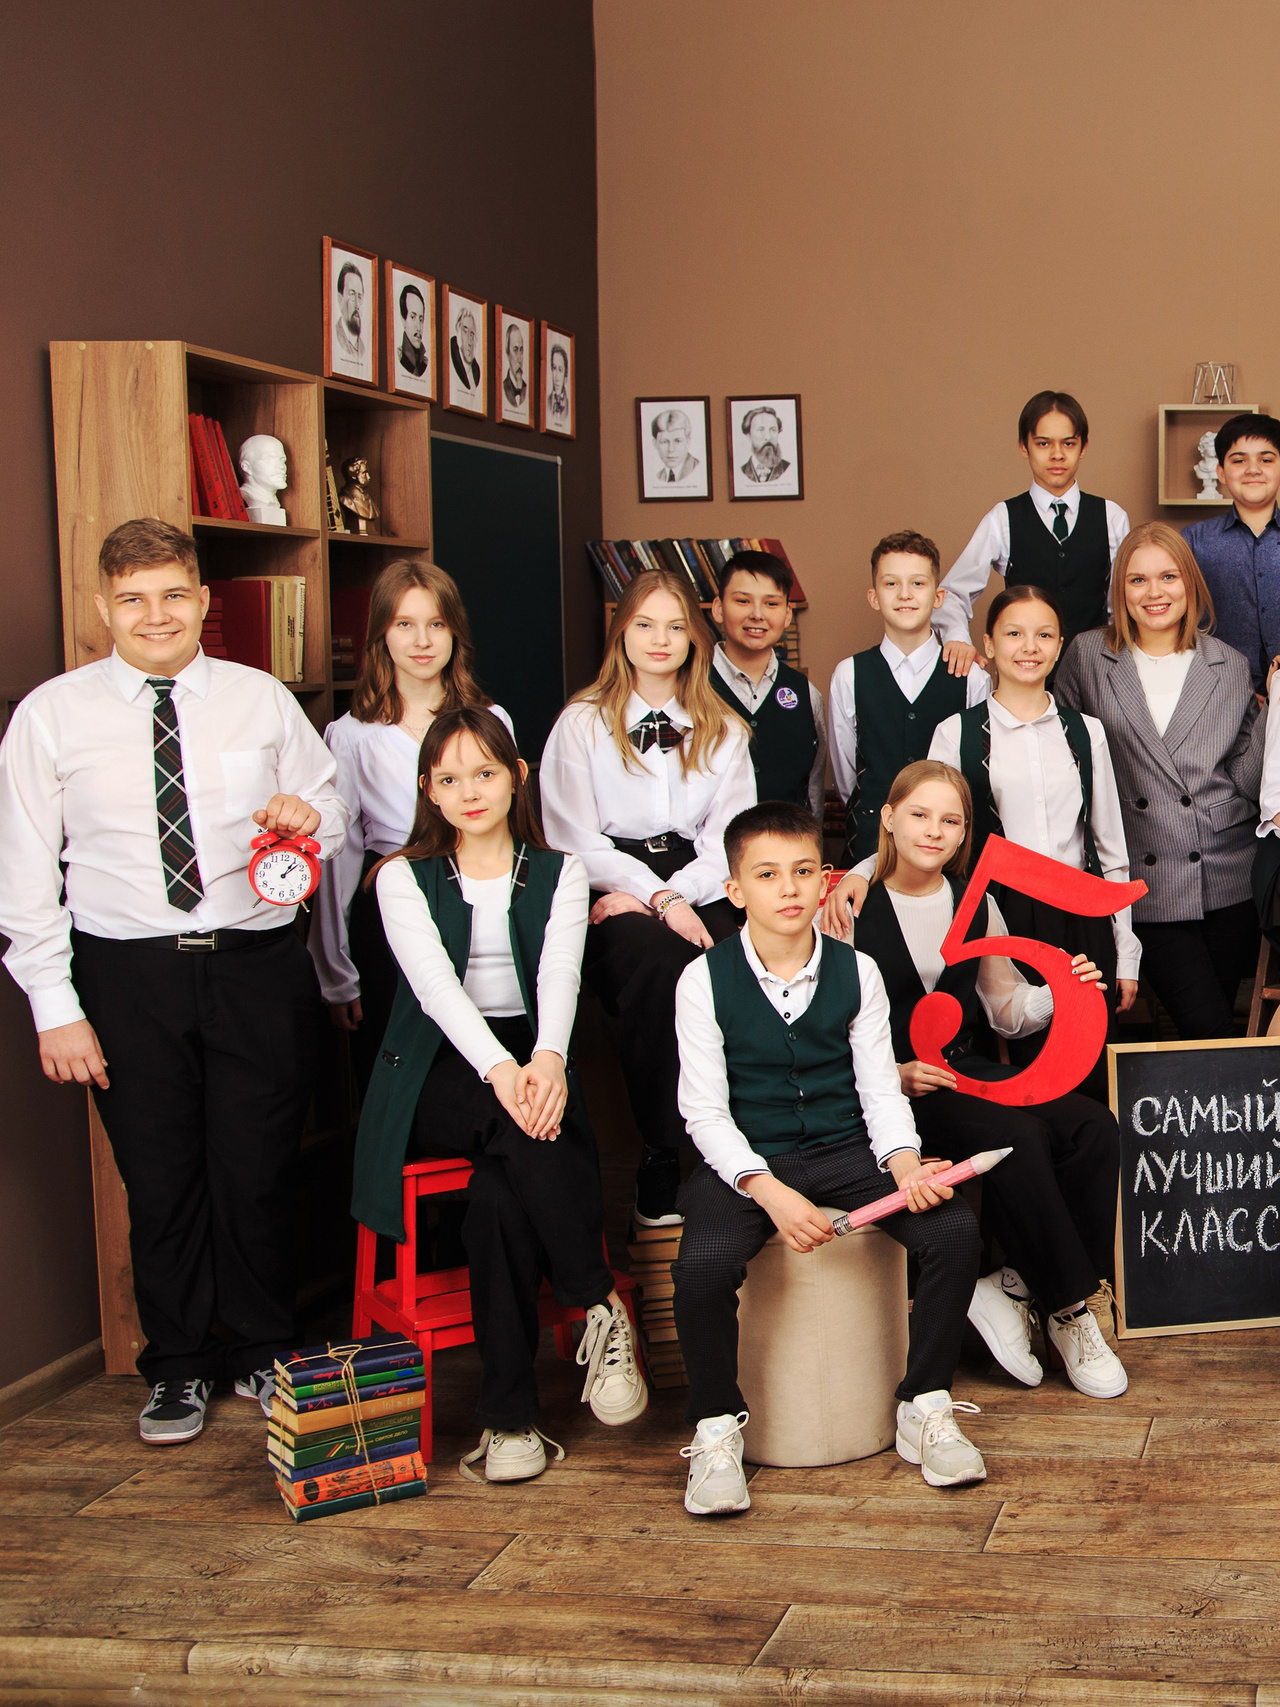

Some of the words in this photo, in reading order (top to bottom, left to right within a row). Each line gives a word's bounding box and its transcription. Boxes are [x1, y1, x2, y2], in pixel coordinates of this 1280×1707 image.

[270, 855, 278, 863] 11
[280, 854, 290, 862] 12
[259, 870, 265, 878] 9
[262, 880, 268, 888] 8
[269, 887, 275, 895] 7
[278, 890, 285, 898] 6
[289, 889, 295, 897] 5
[909, 833, 1149, 1107] 5
[1140, 1204, 1280, 1258] КЛАСС
